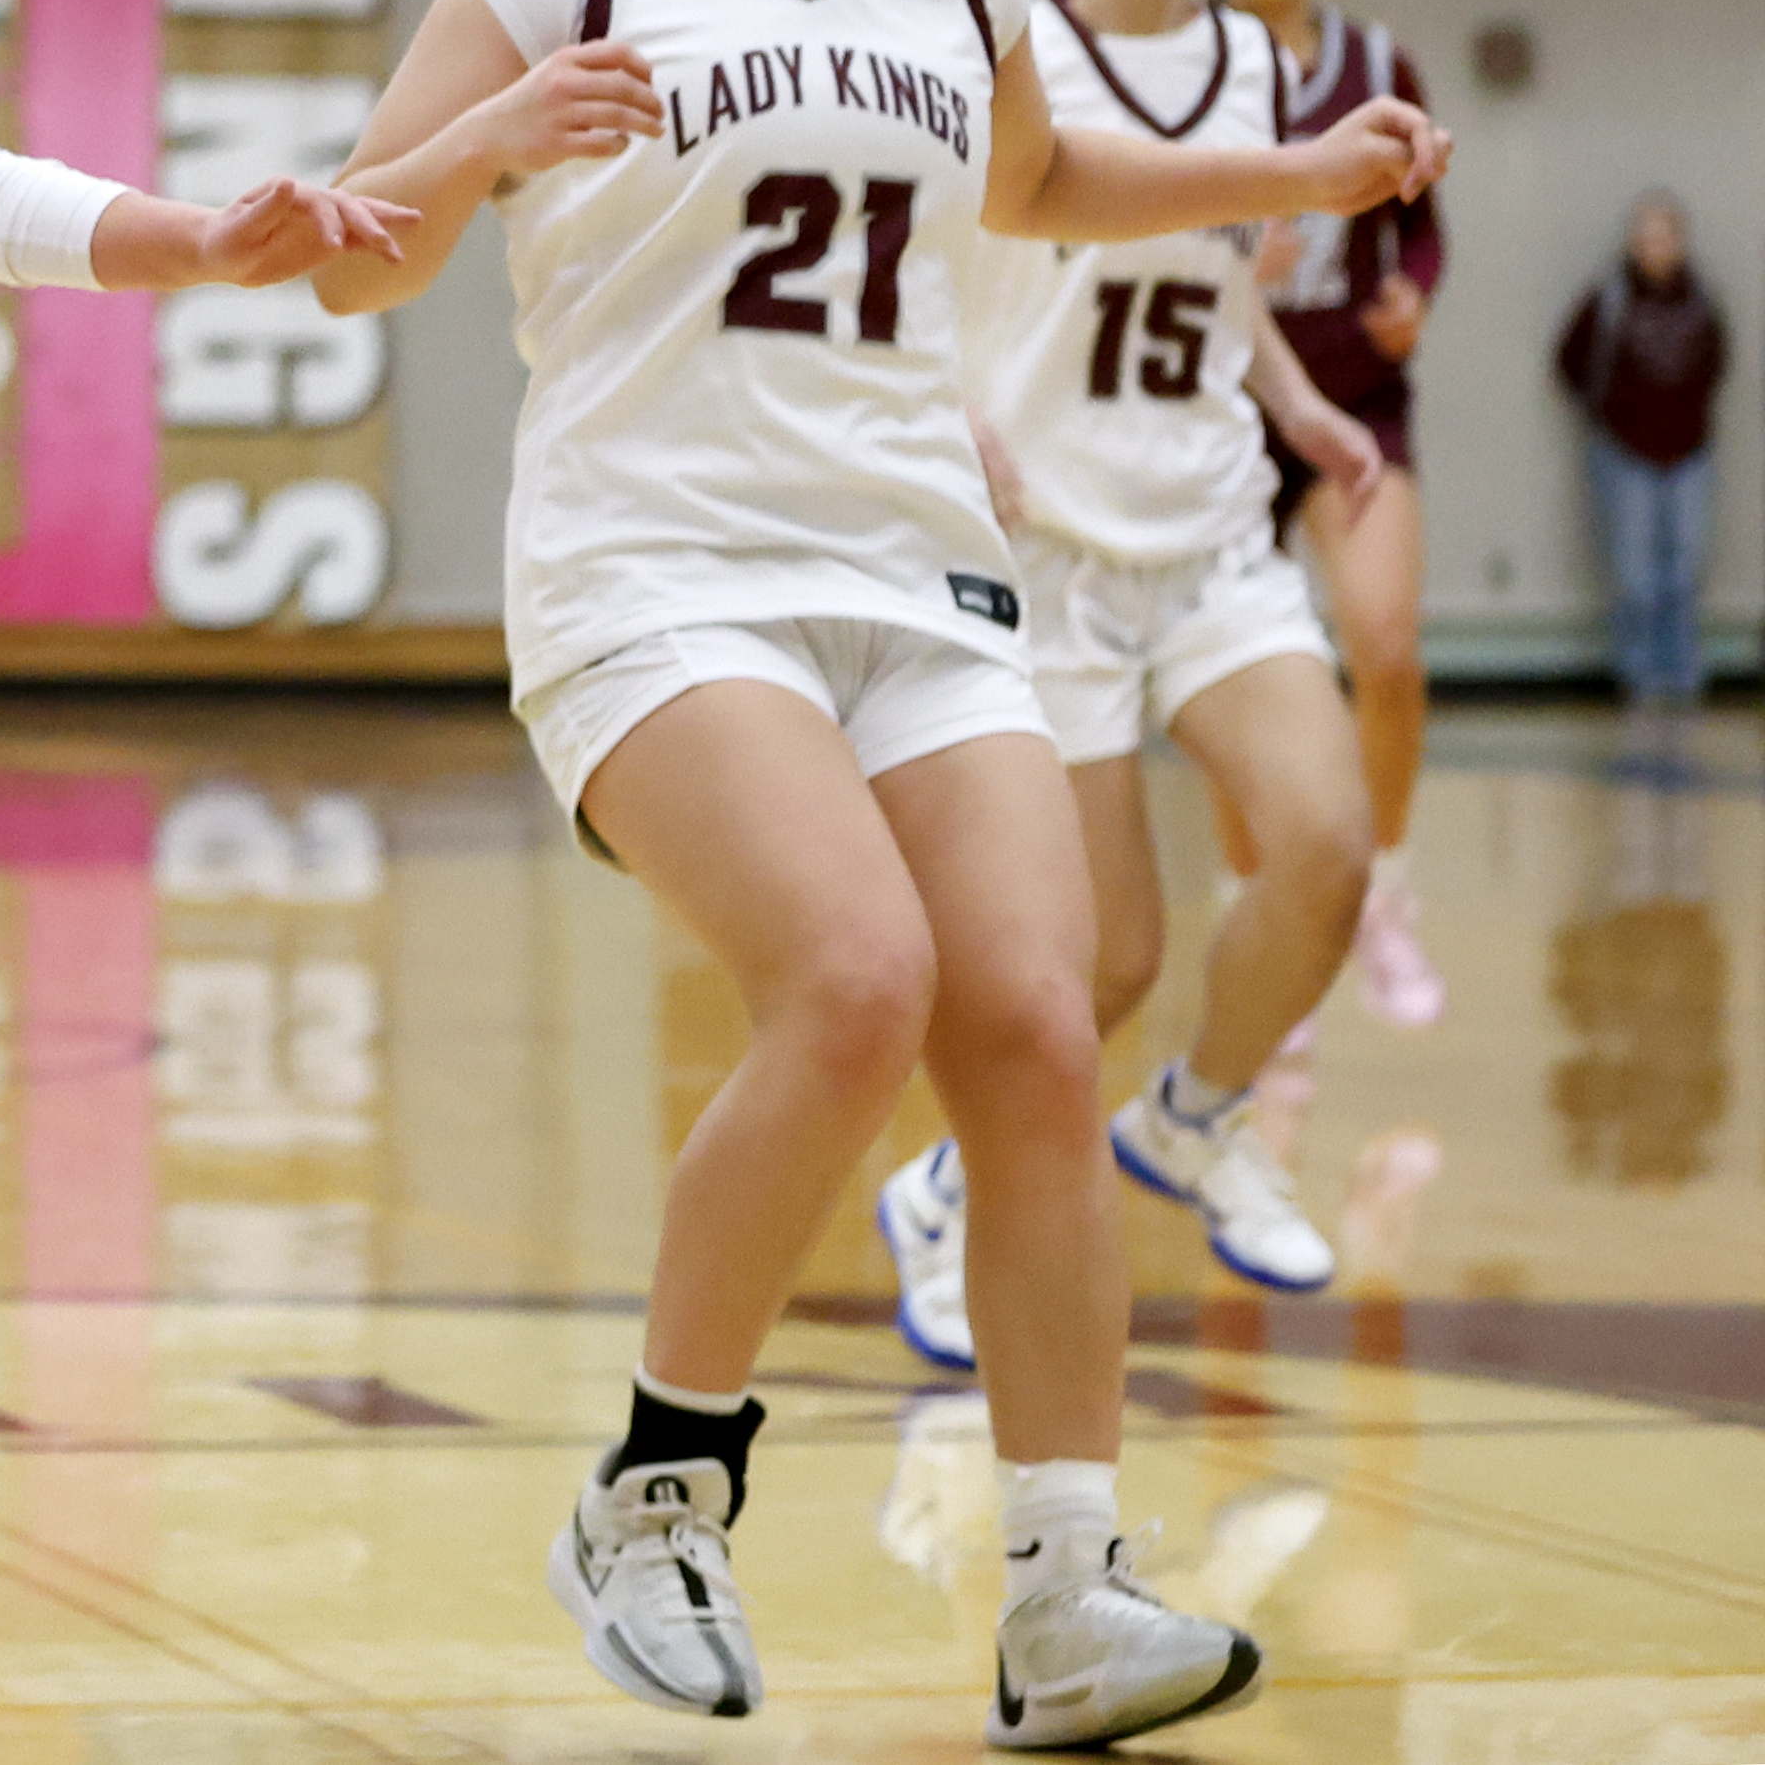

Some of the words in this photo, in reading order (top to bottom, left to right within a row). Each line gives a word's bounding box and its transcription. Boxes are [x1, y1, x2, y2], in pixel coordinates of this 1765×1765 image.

[670, 44, 804, 158] LADY
[827, 45, 969, 165] KINGS
[721, 168, 923, 344] 21
[1087, 276, 1219, 400] 15
